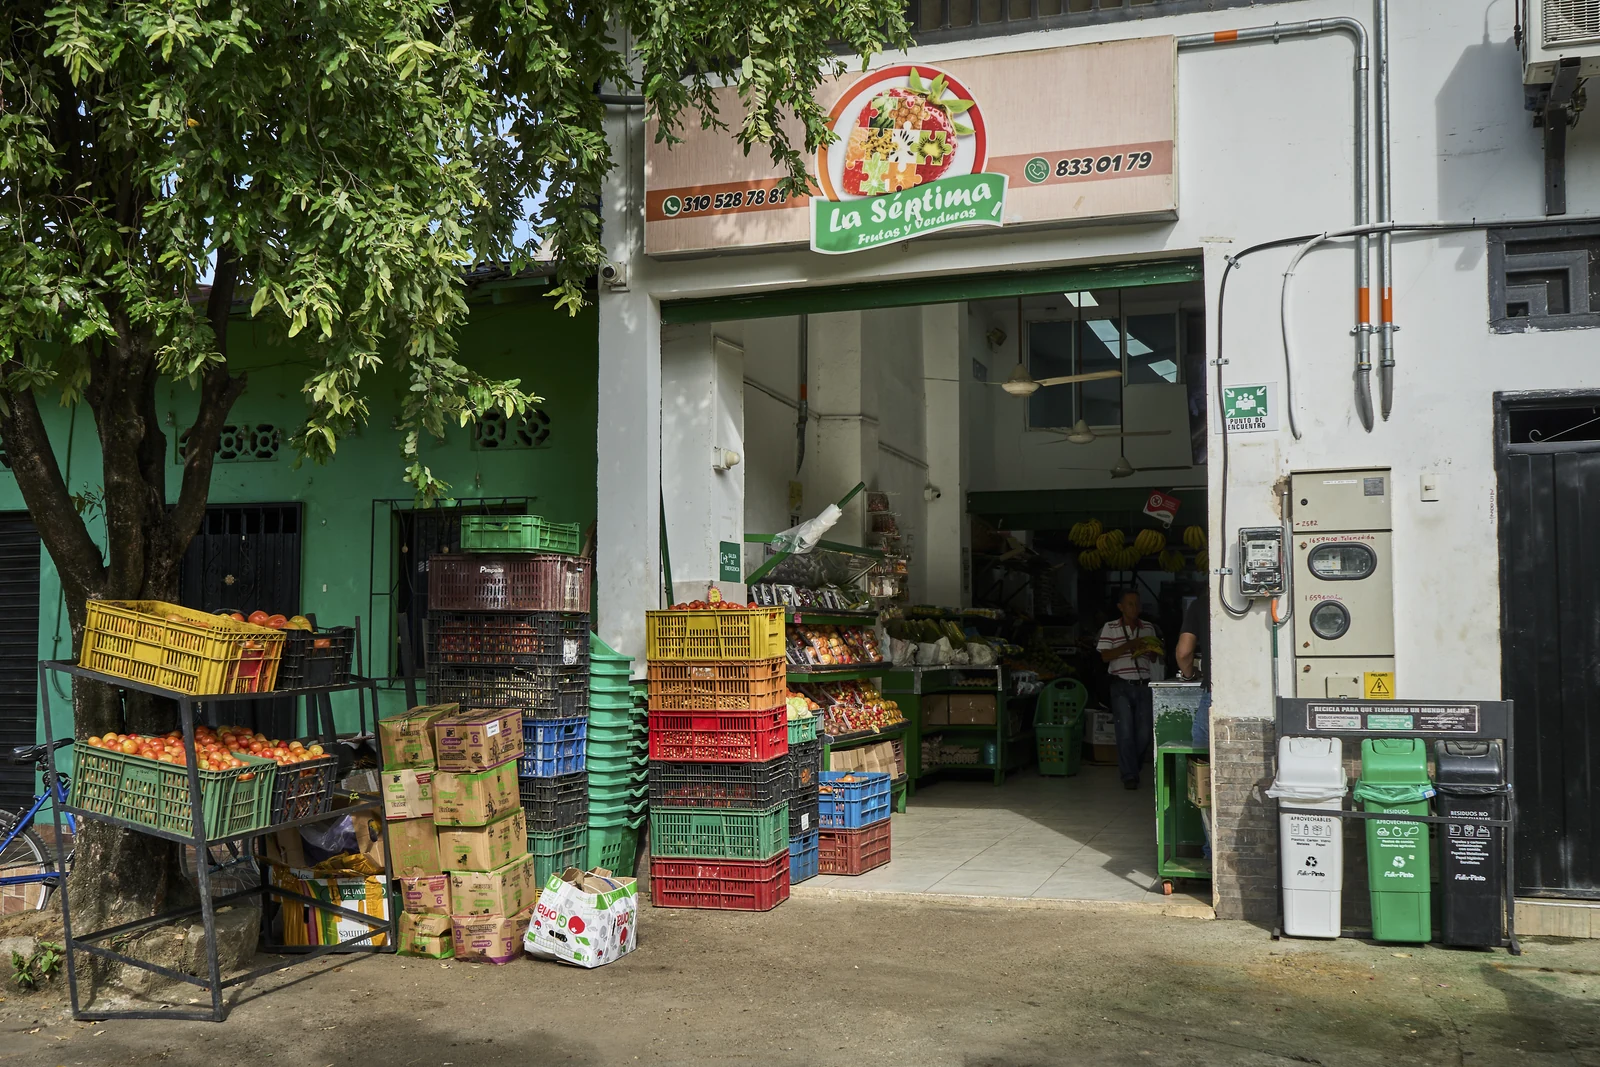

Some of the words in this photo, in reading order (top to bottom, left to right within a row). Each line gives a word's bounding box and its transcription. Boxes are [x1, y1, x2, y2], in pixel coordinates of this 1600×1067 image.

[1055, 157, 1094, 178] 833
[1095, 153, 1124, 174] 01
[1125, 151, 1154, 172] 79
[682, 195, 710, 213] 310
[714, 191, 743, 210] 528
[745, 188, 765, 207] 78
[768, 187, 787, 204] 81
[829, 207, 862, 233] La
[870, 181, 993, 223] Séptima
[858, 227, 901, 246] Frutas
[903, 223, 912, 236] y
[914, 207, 977, 230] Verduras
[1227, 422, 1266, 430] ENCUENTRO
[537, 903, 567, 929] Gloria
